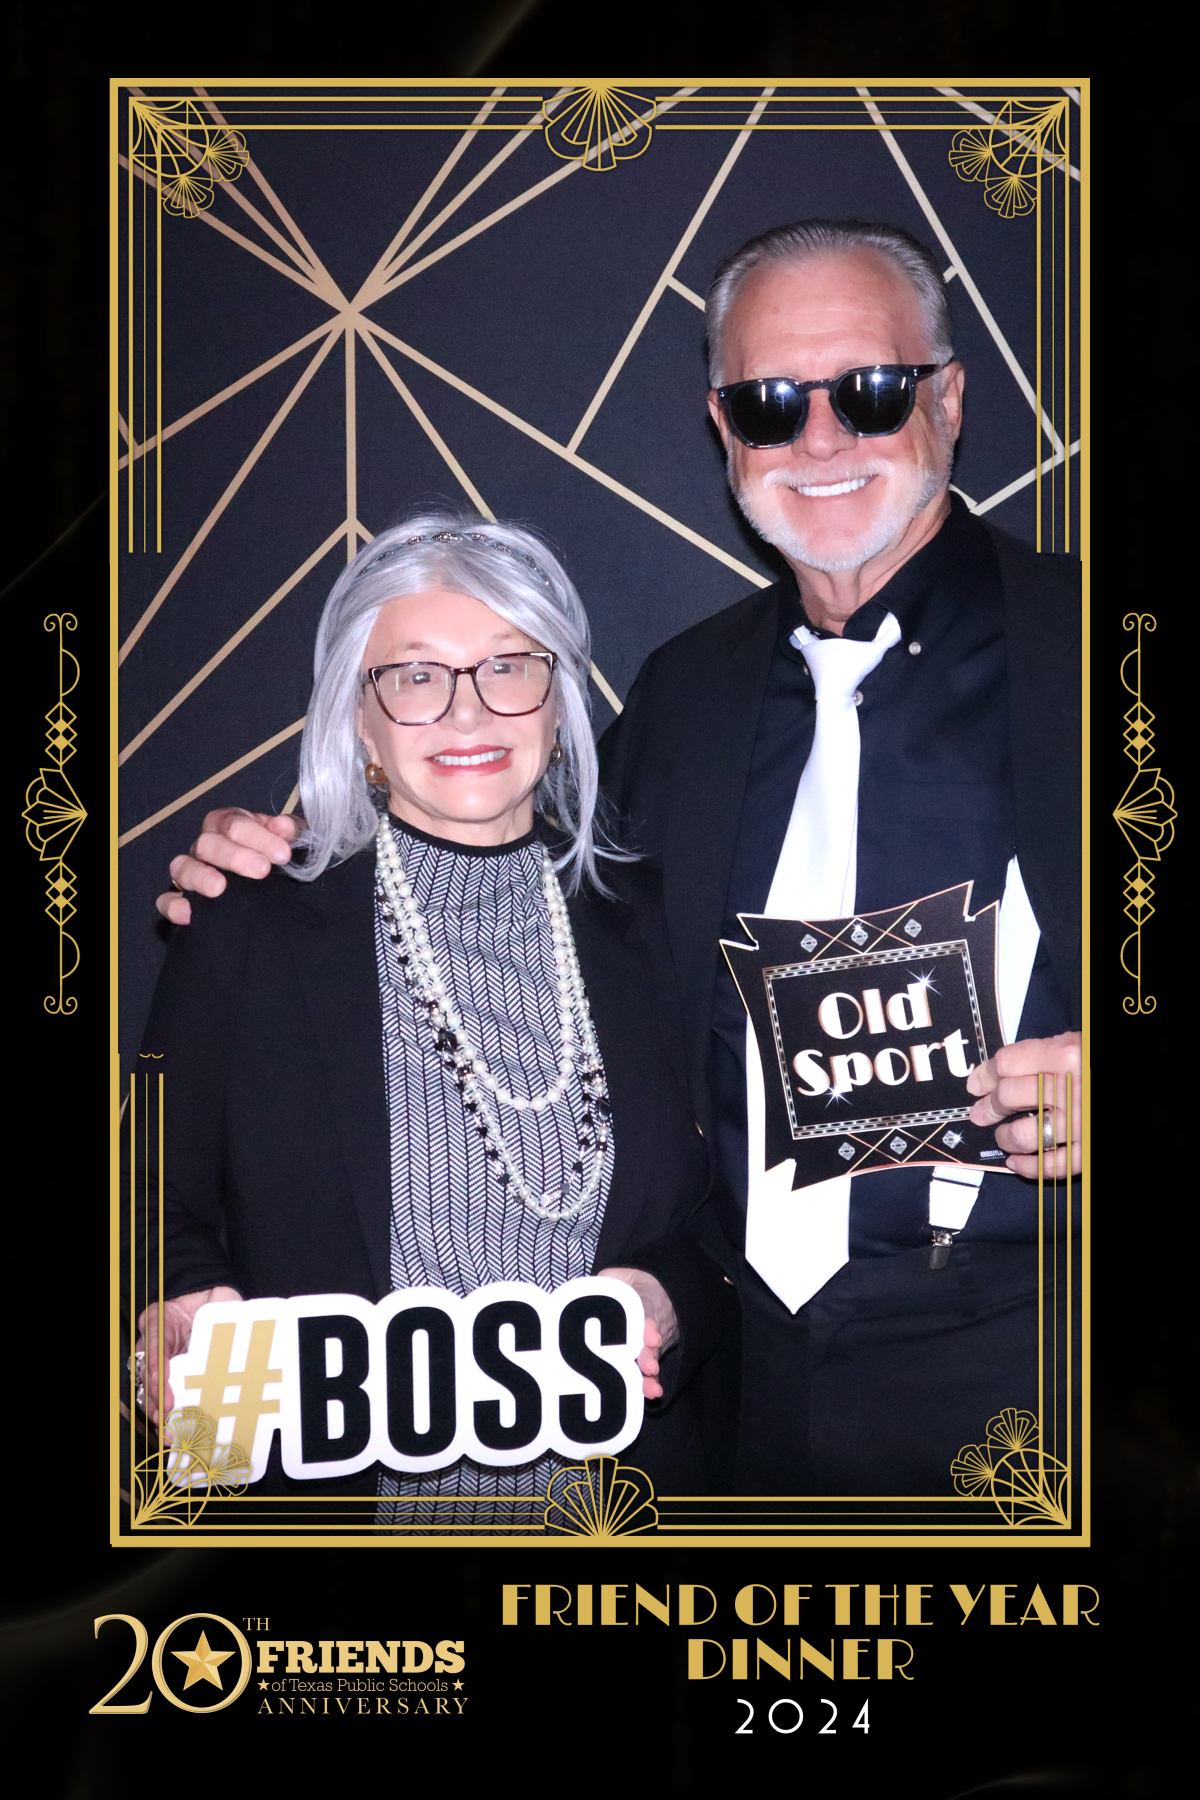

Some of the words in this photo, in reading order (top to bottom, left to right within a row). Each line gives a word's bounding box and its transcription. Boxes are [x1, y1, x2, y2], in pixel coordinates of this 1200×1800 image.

[818, 982, 933, 1040] Old
[792, 1028, 975, 1097] Sport
[184, 1294, 628, 1475] #BOSS
